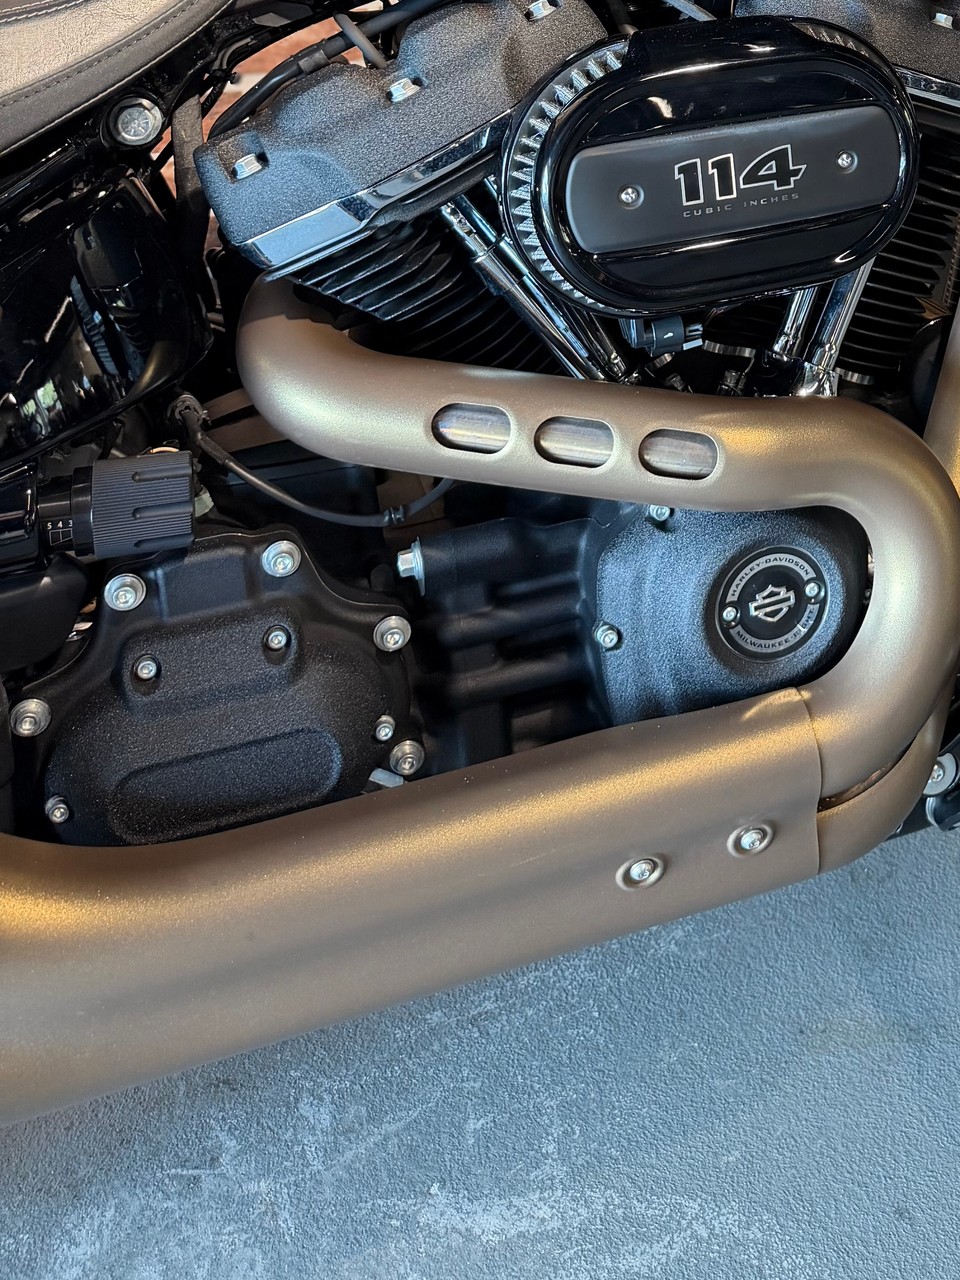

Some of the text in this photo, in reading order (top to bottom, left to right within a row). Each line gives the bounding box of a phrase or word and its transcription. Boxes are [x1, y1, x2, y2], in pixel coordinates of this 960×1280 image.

[674, 143, 808, 207] 114
[682, 192, 800, 218] CUBIC INCHES
[47, 522, 52, 530] 5
[57, 520, 63, 528] 4
[731, 556, 811, 597] HARLEY-DAVIDSON
